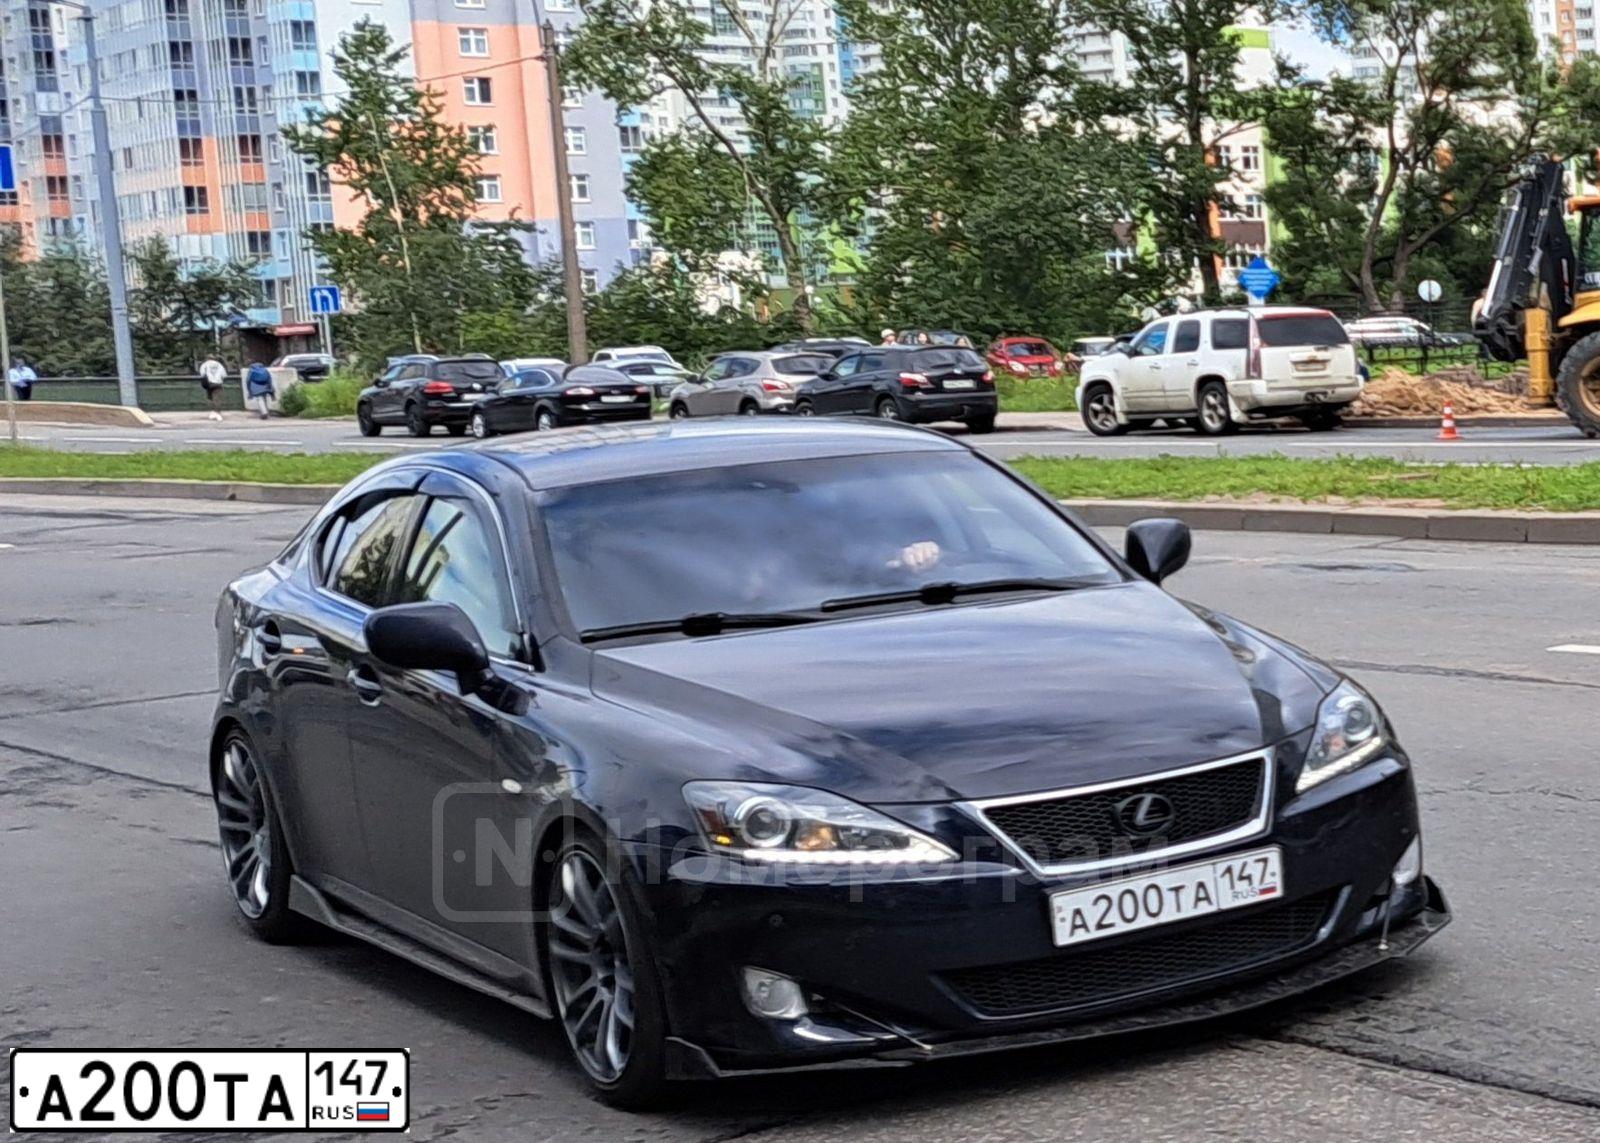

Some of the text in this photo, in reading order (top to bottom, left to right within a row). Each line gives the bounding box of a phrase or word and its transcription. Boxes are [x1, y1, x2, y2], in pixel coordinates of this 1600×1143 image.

[1069, 857, 1269, 937] А200ТА 147
[1231, 885, 1258, 901] RUS
